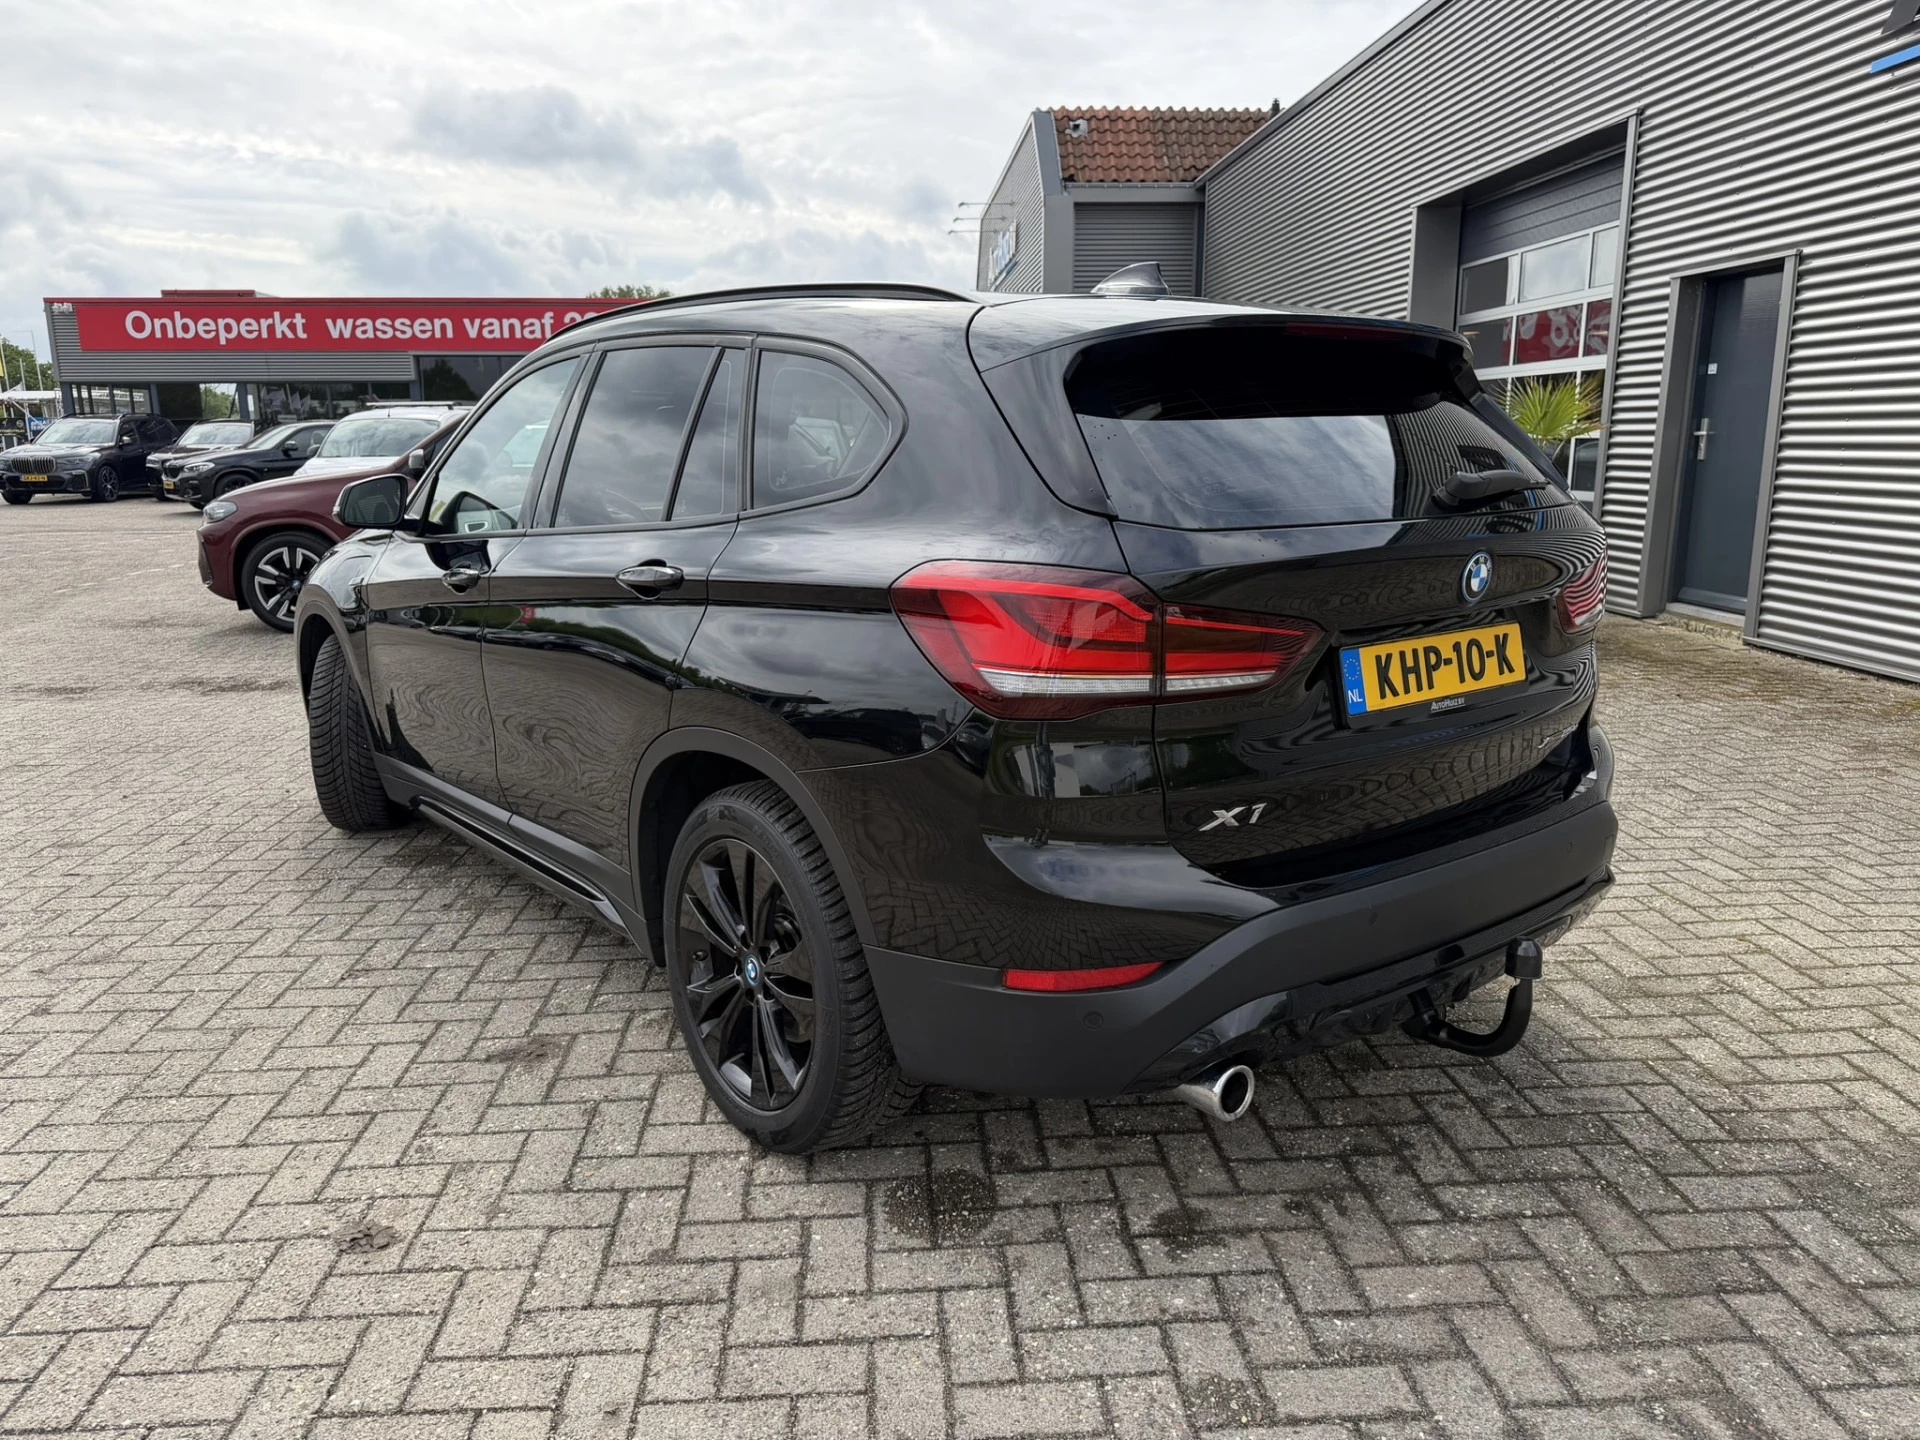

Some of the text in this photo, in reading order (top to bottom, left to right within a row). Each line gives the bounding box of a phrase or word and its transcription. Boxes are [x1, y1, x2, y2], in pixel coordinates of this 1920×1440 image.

[125, 310, 307, 345] Onbeperkt
[325, 318, 453, 339] wassen
[463, 311, 555, 339] vanaf
[1375, 633, 1515, 700] KHP-10-K
[1348, 689, 1364, 704] NL
[1199, 803, 1268, 831] X1
